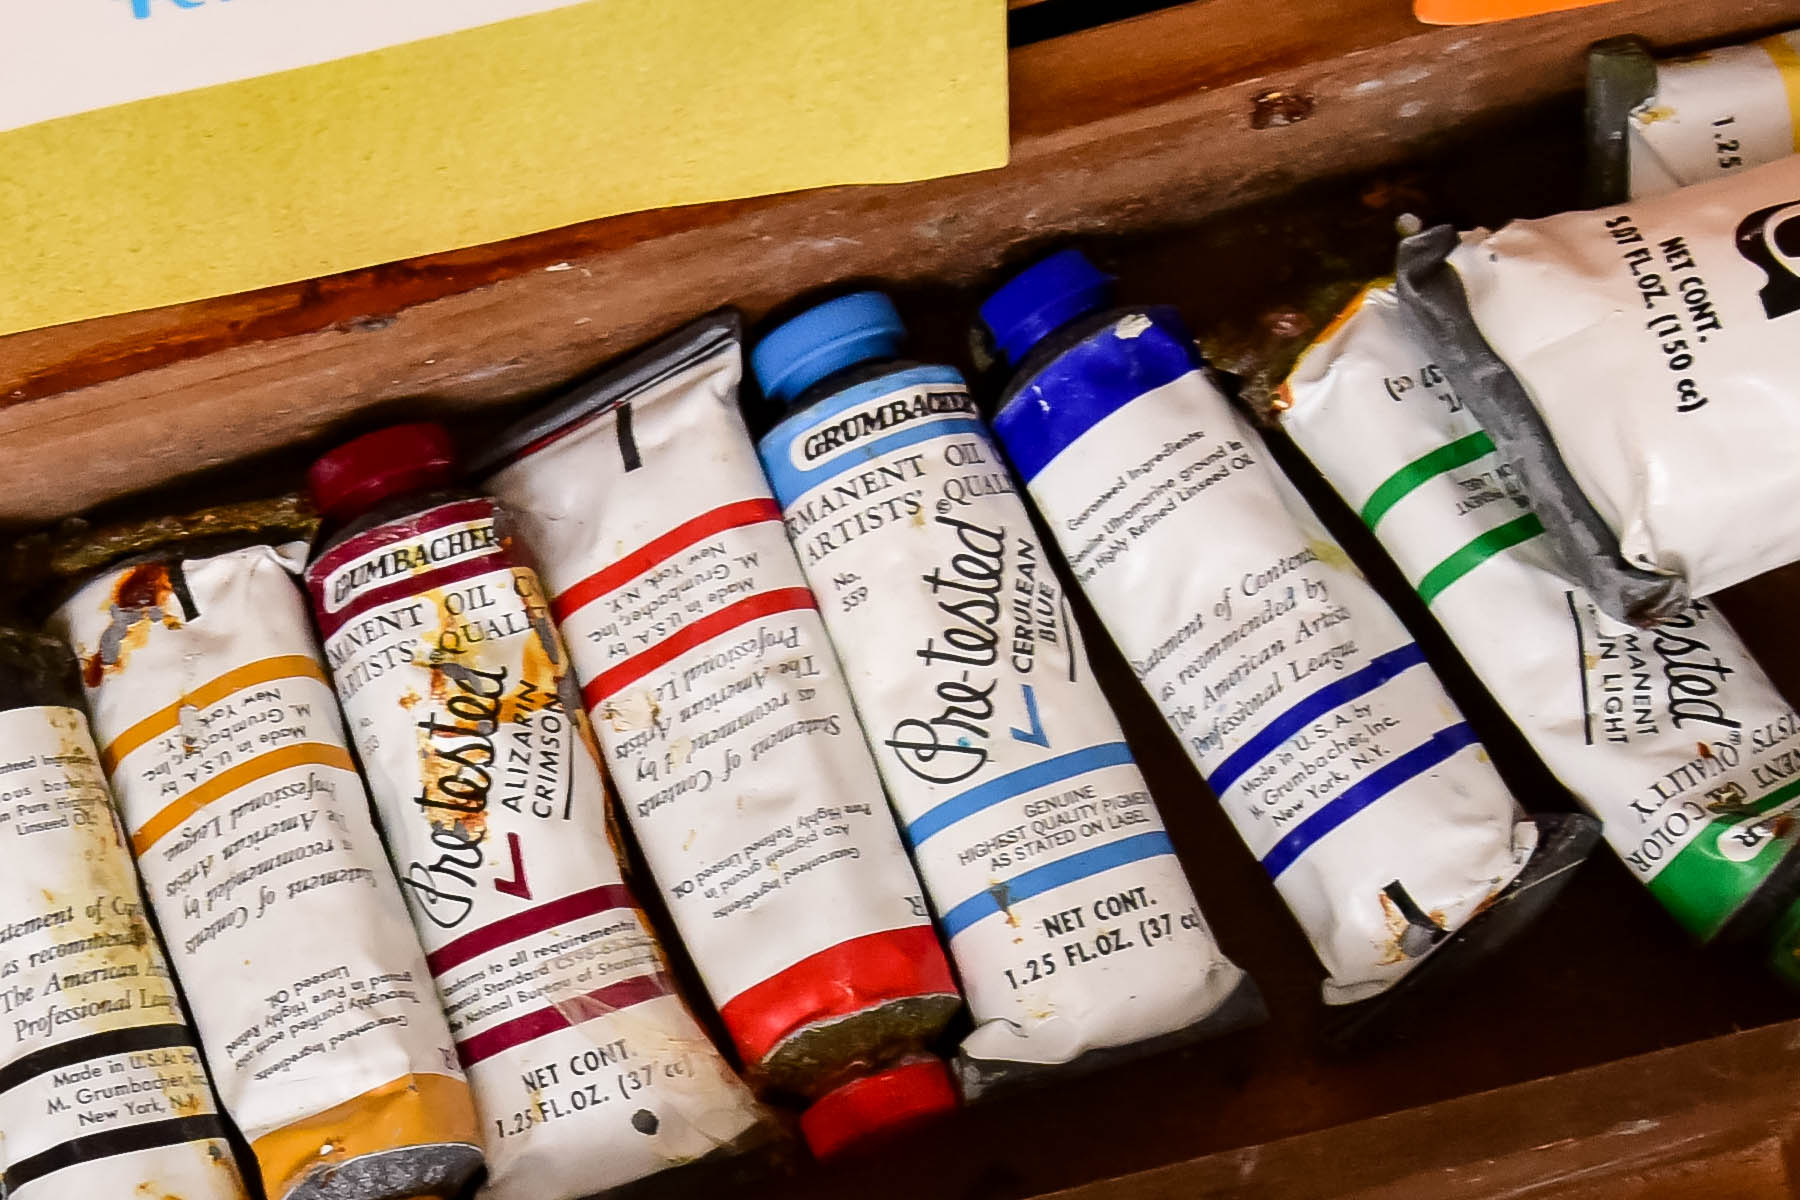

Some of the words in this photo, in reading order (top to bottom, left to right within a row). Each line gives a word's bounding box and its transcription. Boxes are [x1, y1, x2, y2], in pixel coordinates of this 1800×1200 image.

[1658, 237, 1695, 271] NET
[1679, 277, 1722, 342] CONT.
[1648, 314, 1693, 370] (150
[1677, 379, 1708, 412] cc)
[944, 437, 986, 466] OIL
[685, 539, 727, 565] New
[442, 585, 494, 618] OIL
[685, 601, 703, 613] in
[709, 578, 754, 603] Made
[1012, 538, 1035, 673] CERULEAN
[1038, 583, 1058, 643] BLUE
[877, 516, 1005, 784] Pre-tested
[1604, 674, 1629, 743] LIGHT
[502, 678, 540, 812] ALIZARIN
[533, 689, 568, 818] CRIMSON
[722, 749, 740, 782] of
[1025, 785, 1096, 817] GENUINE
[1630, 742, 1739, 823] QUALITY
[959, 826, 1026, 865] HIGHEST
[1033, 803, 1097, 835] QUALITY
[1270, 798, 1305, 828] New
[1623, 802, 1707, 872] COLOR
[992, 853, 1011, 871] AS
[1015, 830, 1076, 860] STATED
[1081, 821, 1105, 837] ON
[1108, 810, 1150, 829] LABEL
[1043, 907, 1085, 938] NET
[1094, 887, 1156, 920] CONT.
[45, 959, 142, 995] American
[488, 959, 504, 975] to
[509, 951, 528, 967] all
[1005, 953, 1055, 989] 1.25
[1064, 929, 1133, 966] FL.OZ.
[1140, 914, 1171, 946] (37
[14, 987, 134, 1041] Professional
[54, 1065, 101, 1087] Made
[107, 1061, 124, 1073] in
[522, 1064, 558, 1093] NET
[570, 1039, 628, 1075] CONT.
[48, 1097, 71, 1114] M.
[76, 1105, 120, 1127] New
[124, 1098, 165, 1115] York,
[496, 1109, 536, 1138] 1.25
[618, 1064, 653, 1099] (37
